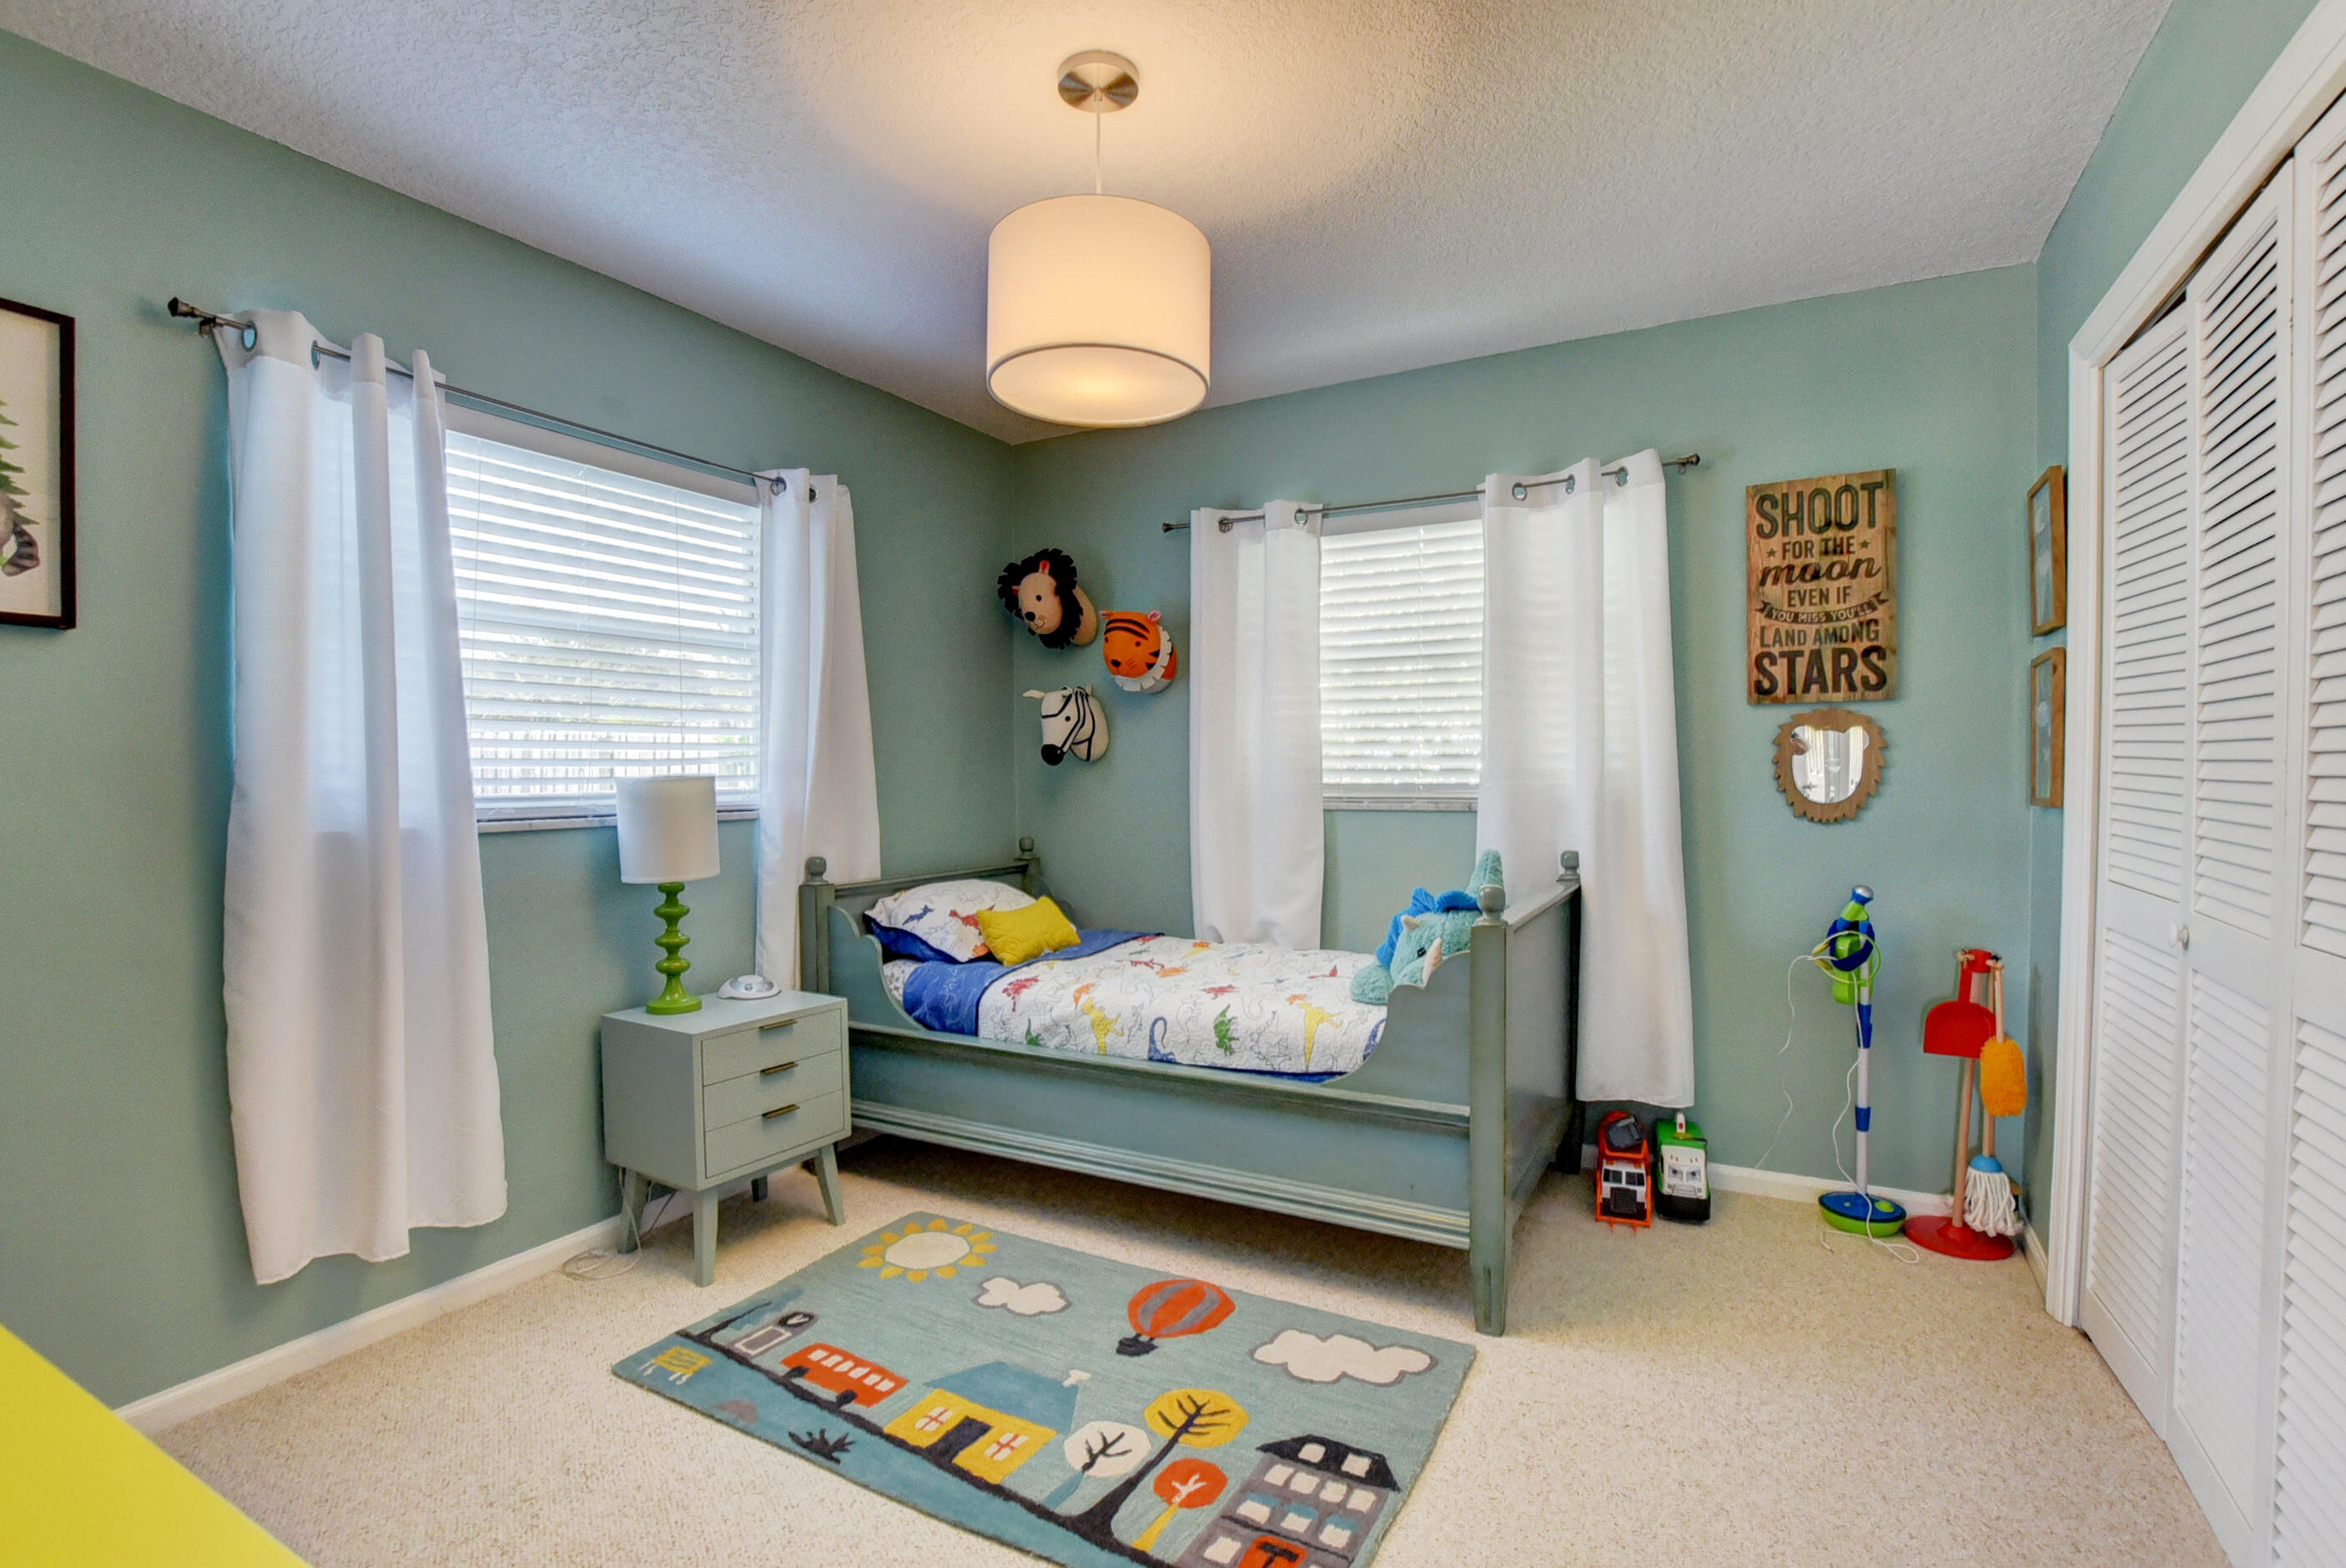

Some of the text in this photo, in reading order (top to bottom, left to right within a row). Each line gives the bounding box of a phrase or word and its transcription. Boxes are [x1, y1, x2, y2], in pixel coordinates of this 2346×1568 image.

[1755, 481, 1884, 540] SHOOT
[1782, 535, 1855, 560] FOR THE
[1759, 556, 1881, 587] moon
[1787, 585, 1852, 607] EVEN IF
[1771, 603, 1872, 623] YOU MISS YOU'LL
[1760, 619, 1880, 648] LAND AMONG
[1754, 646, 1888, 696] STARS
